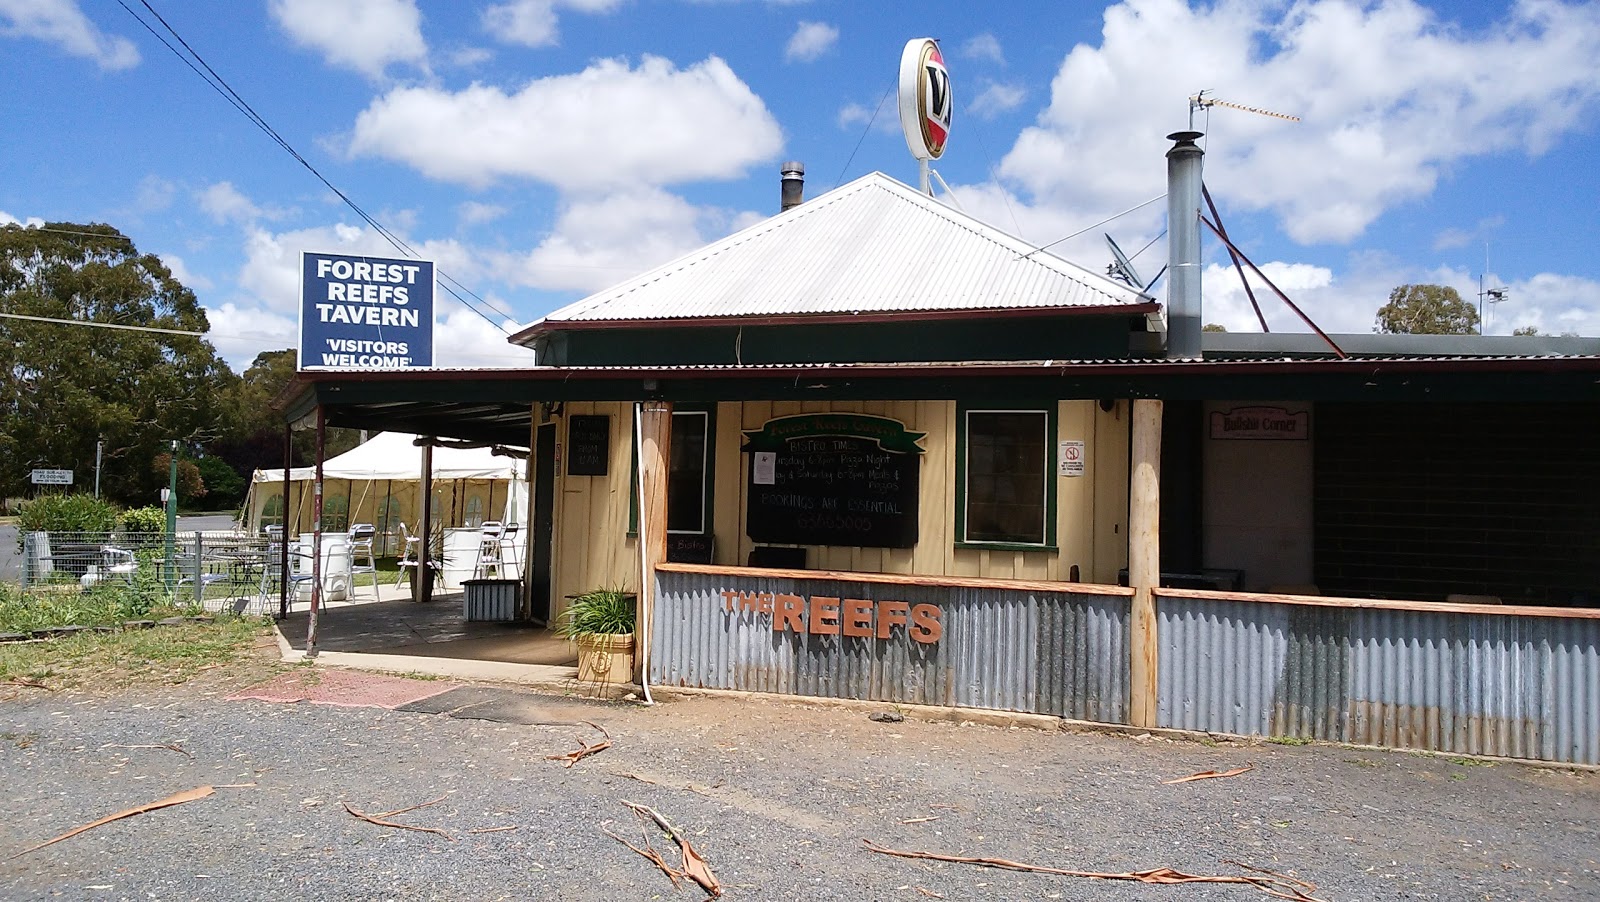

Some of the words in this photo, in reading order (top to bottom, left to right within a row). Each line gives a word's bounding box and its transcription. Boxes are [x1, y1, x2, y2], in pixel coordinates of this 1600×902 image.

[317, 259, 420, 285] FOREST
[327, 282, 409, 306] REEFS
[316, 303, 419, 327] TAVERN
[326, 338, 409, 355] 'VISITORS
[321, 353, 413, 367] WELCOME'
[1262, 418, 1297, 432] Corner
[790, 440, 826, 452] BISTRO
[866, 453, 890, 470] Night
[797, 469, 833, 485] Saturday
[761, 493, 814, 509] BOOKINGS
[822, 497, 839, 509] ARE
[848, 499, 902, 514] ESSENTIAL
[721, 591, 773, 613] THE
[773, 593, 943, 644] REEFS
